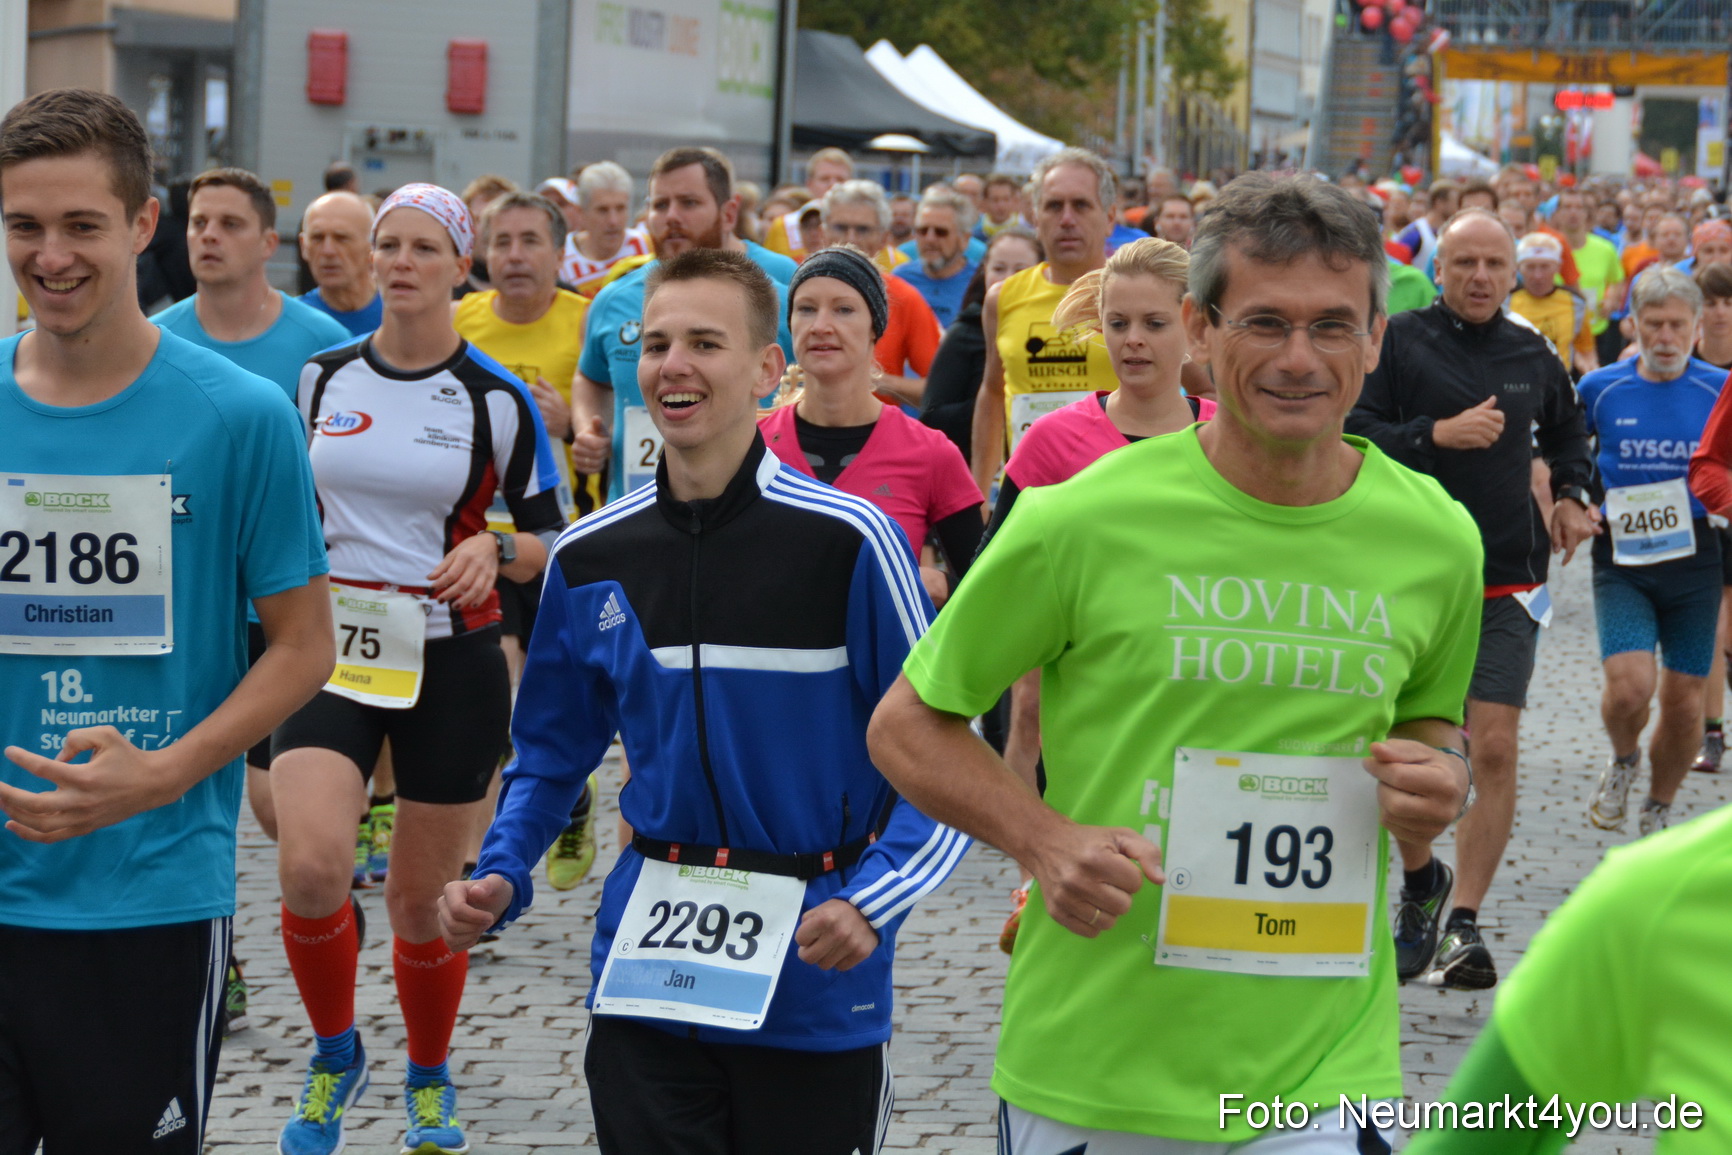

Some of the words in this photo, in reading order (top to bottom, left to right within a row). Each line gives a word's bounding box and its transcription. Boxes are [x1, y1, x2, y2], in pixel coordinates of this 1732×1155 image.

[1028, 365, 1088, 377] HIRSCH
[431, 394, 462, 406] SUGOI
[424, 426, 443, 434] team
[427, 433, 460, 443] klinikum
[413, 437, 449, 449] nürnberg
[43, 492, 111, 508] BOCK
[1620, 505, 1679, 534] 2466
[0, 530, 140, 584] 2186
[25, 603, 113, 623] Christian
[1164, 574, 1393, 639] NOVINA
[598, 613, 626, 631] adidas
[340, 624, 380, 660] 75
[1168, 635, 1385, 698] HOTELS
[41, 669, 93, 703] 18.
[339, 669, 372, 685] Hana
[41, 706, 159, 726] Neumarkter
[1262, 775, 1328, 795] BOCK
[1226, 822, 1334, 889] 193
[692, 865, 751, 885] BOCK
[1176, 873, 1185, 886] C
[638, 900, 764, 961] 2293
[1254, 912, 1296, 936] Tom
[663, 969, 696, 989] Jan
[852, 1002, 875, 1012] climacool
[153, 1117, 186, 1139] adidas
